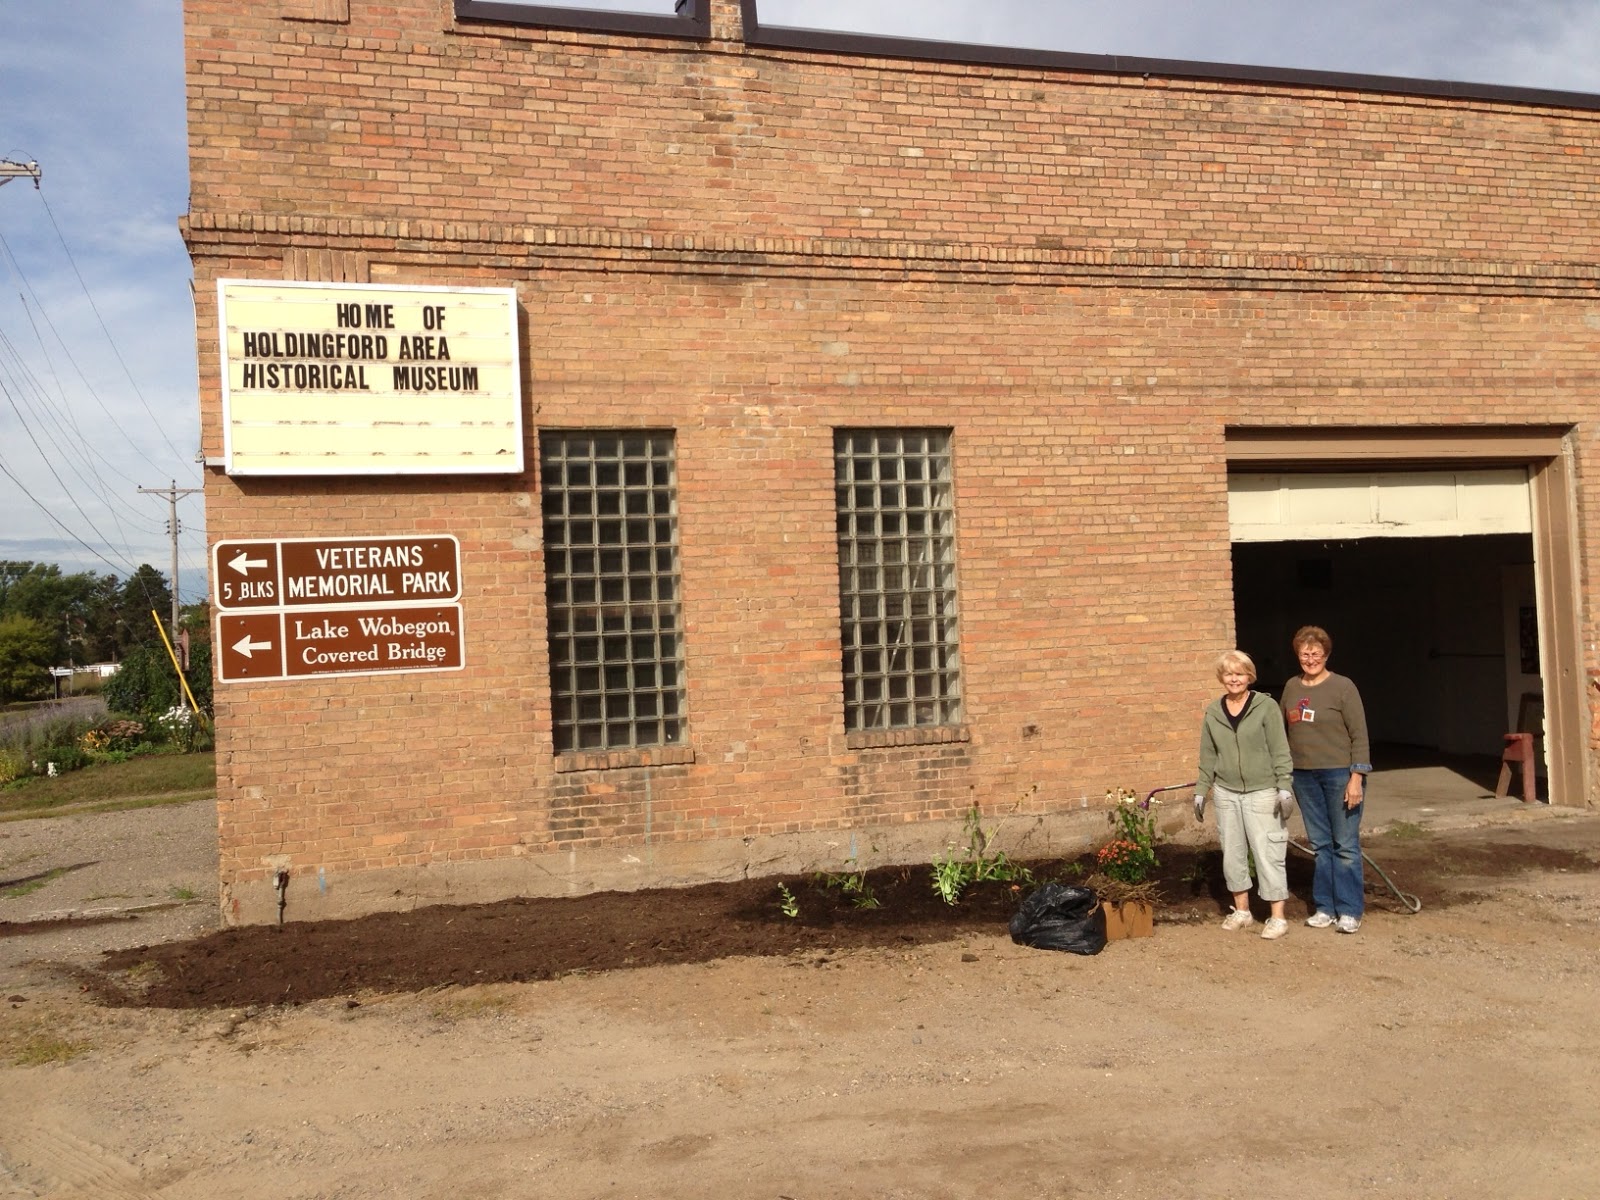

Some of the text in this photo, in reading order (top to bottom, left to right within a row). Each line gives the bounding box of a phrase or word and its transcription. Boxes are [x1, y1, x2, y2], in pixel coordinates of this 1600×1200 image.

[337, 303, 445, 330] HOME OF
[243, 332, 451, 360] HOLDINGFORD AREA
[243, 363, 479, 391] HISTORICAL MUSEUM
[315, 545, 424, 569] VETERANS
[223, 581, 274, 600] 5 BLKS
[288, 571, 451, 598] MEMORIAL PARK
[295, 616, 451, 640] Lake Wobegon
[302, 642, 446, 665] Covered Bridge
